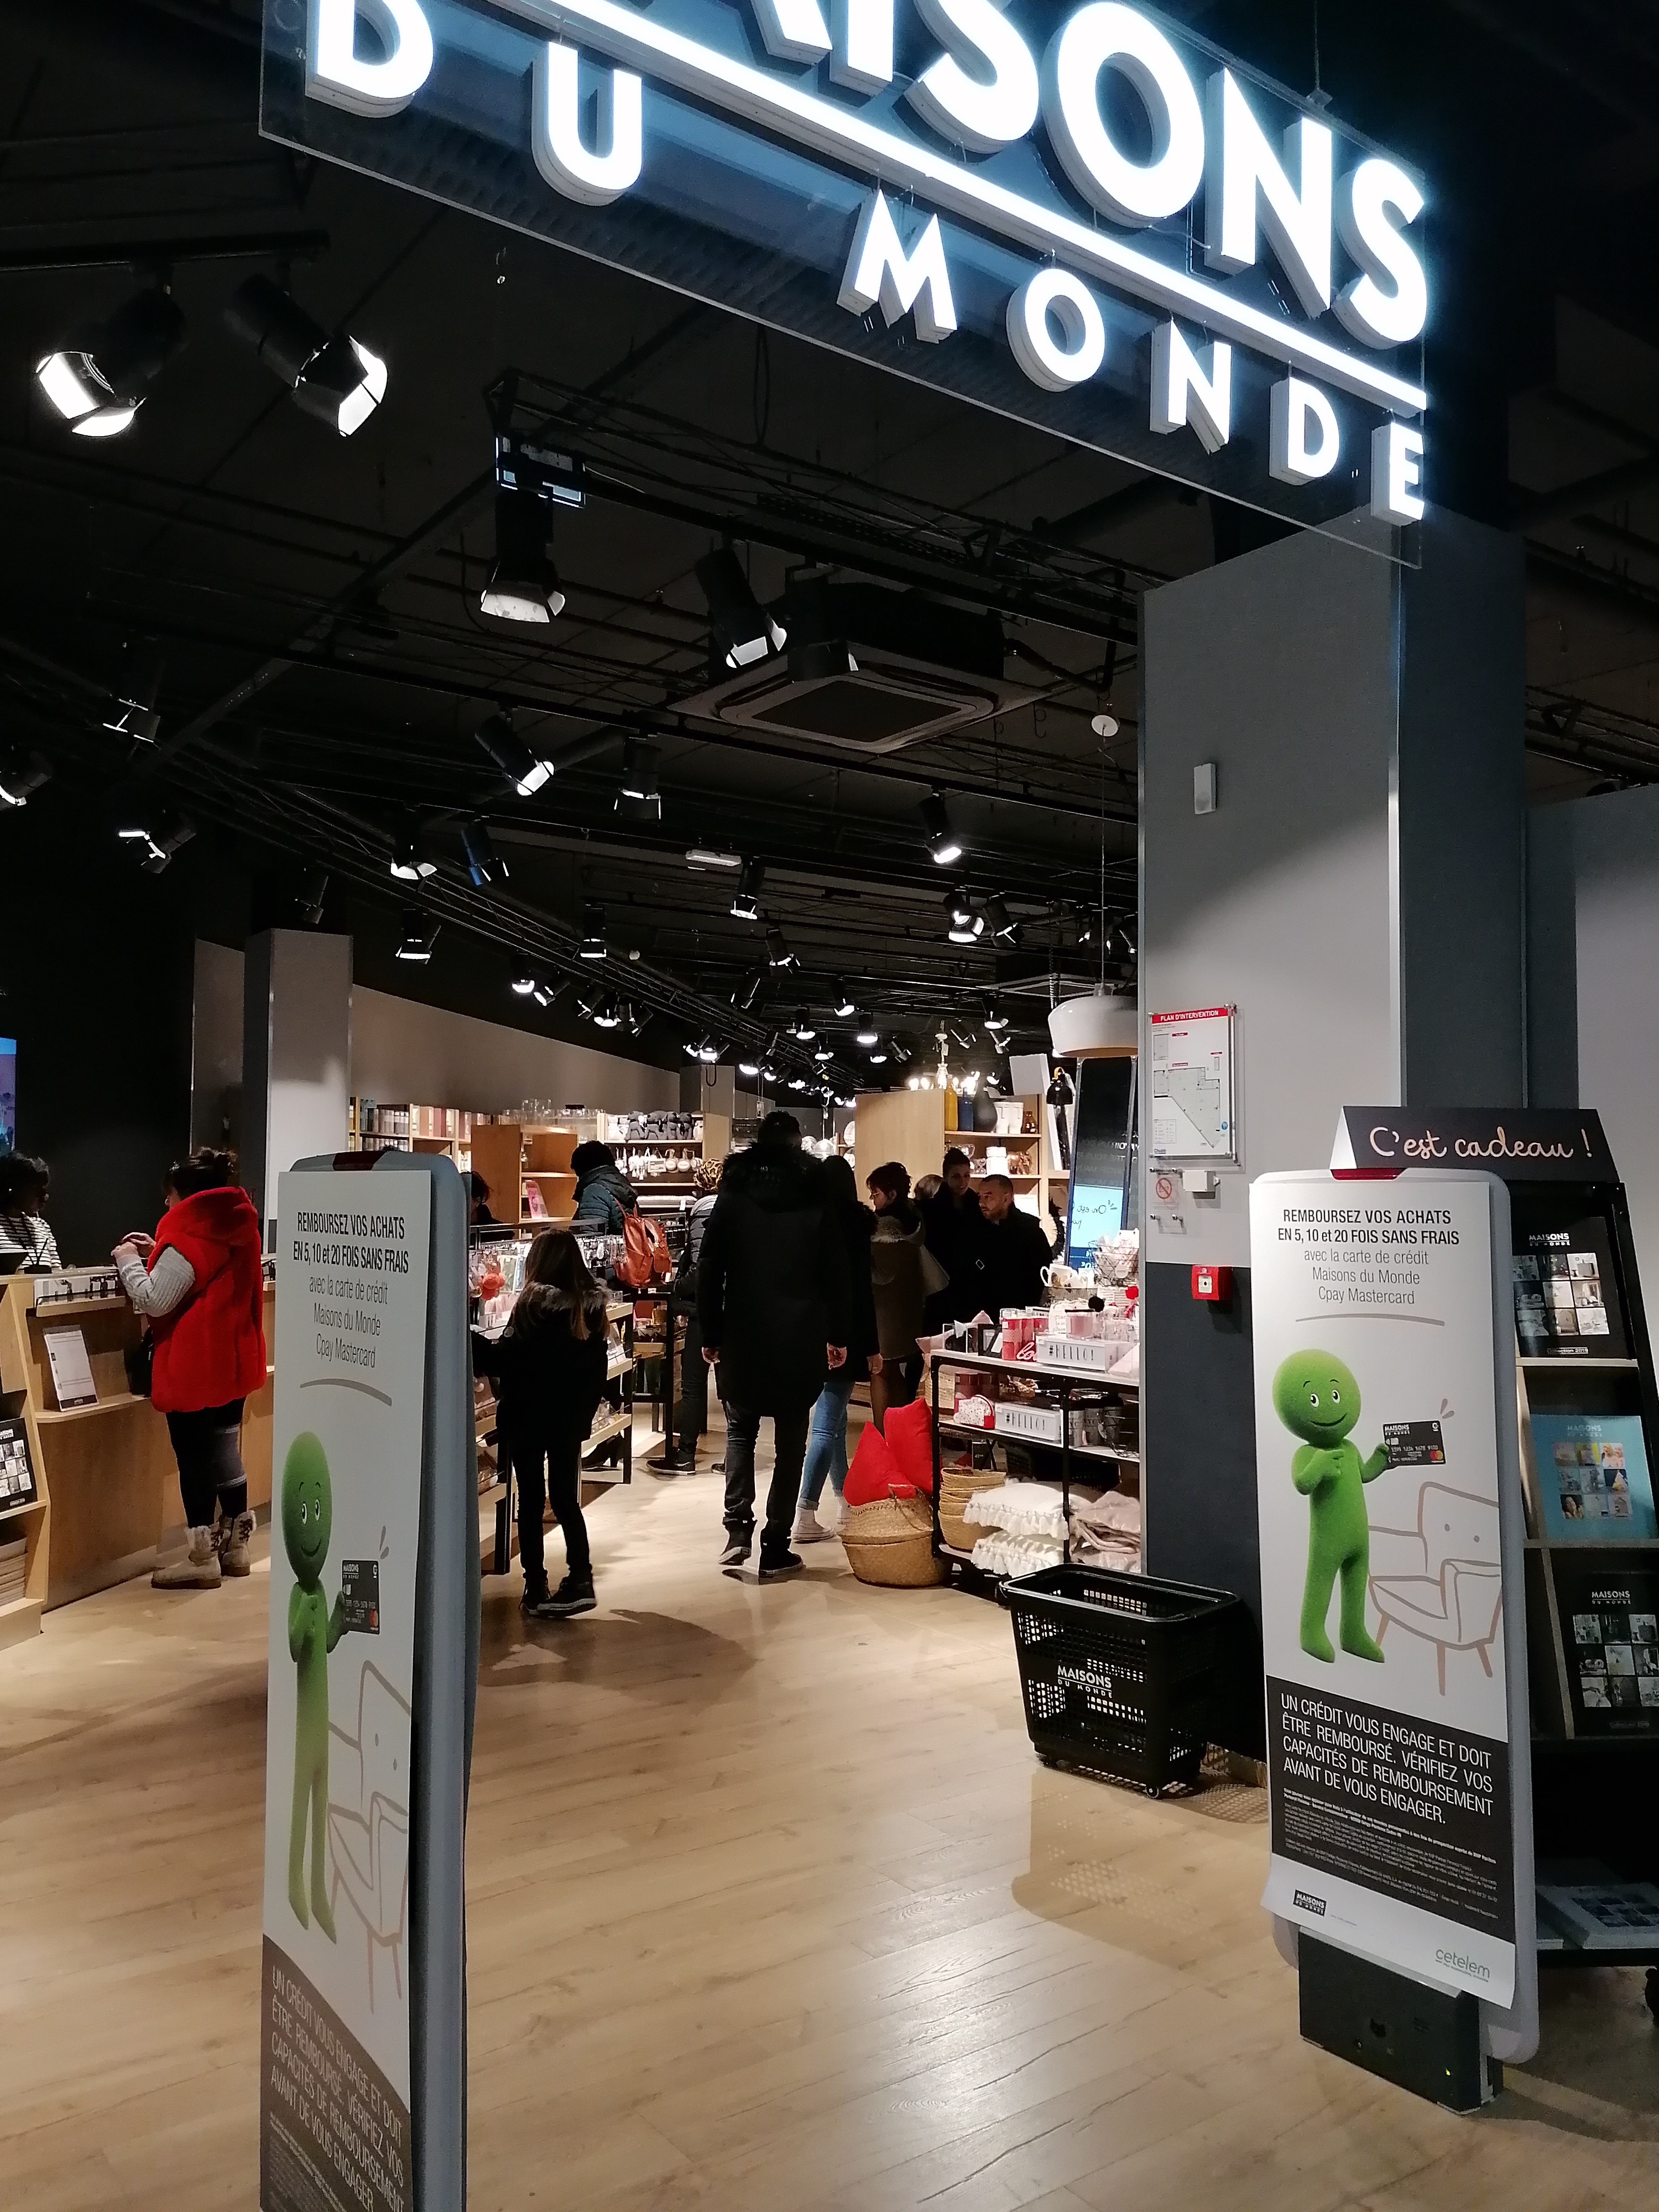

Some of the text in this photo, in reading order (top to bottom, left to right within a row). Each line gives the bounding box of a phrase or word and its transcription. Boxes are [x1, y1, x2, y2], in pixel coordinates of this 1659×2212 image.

[309, 0, 1427, 523] DU MONDE
[1175, 1010, 1219, 1020] D'INTERVENTION
[1370, 1126, 1592, 1159] C'est cadeau !
[298, 1212, 405, 1239] REMBOURSEZ VOS ACHATS
[1284, 1209, 1451, 1224] REMBOURSEZ VOS ACHATS
[1278, 1228, 1459, 1245] EN 5, 10 et 20 FOIS SANS FRAIS
[1529, 1233, 1569, 1241] MAISONS
[294, 1241, 409, 1274] EN 5, 10 et 20 FOIS SANS FRAIS
[1305, 1249, 1429, 1264] avec la carte de crédit
[310, 1275, 388, 1305] avec la carte de crédit
[1313, 1267, 1420, 1285] Maisons du Monde
[1319, 1287, 1415, 1304] Cpay Mastercard
[314, 1303, 380, 1336] Maisons du Monde
[317, 1333, 375, 1368] Cpay Mastercard
[1058, 1665, 1112, 1688] MAISONS
[1058, 1678, 1112, 1698] DU MONDE
[1281, 1693, 1491, 1770] UN CRÉDIT VOUS ENGAGE ET DOIT
[1282, 1712, 1493, 1792] ÊTRE REMBOURSÉ. VÉRIFIEZ VOS
[1284, 1736, 1493, 1816] CAPACITÉS DE REMBOURSEMENT
[1284, 1757, 1446, 1824] AVANT DE VOUS ENGAGER.
[1297, 1893, 1324, 1908] MAISONS
[1436, 1949, 1490, 1978] cetelem
[273, 1965, 403, 2147] UN CRÉDIT VOUS ENGAGE ET DOIT
[272, 2031, 315, 2100] CAPACITÉS
[317, 2083, 327, 2117] DE
[272, 1995, 403, 2188] ÊTRE REMBOURSÉ. VÉRIFIEZ VOS
[271, 2065, 297, 2110] AVANT
[300, 2098, 310, 2129] DE
[311, 2115, 332, 2158] VOUS
